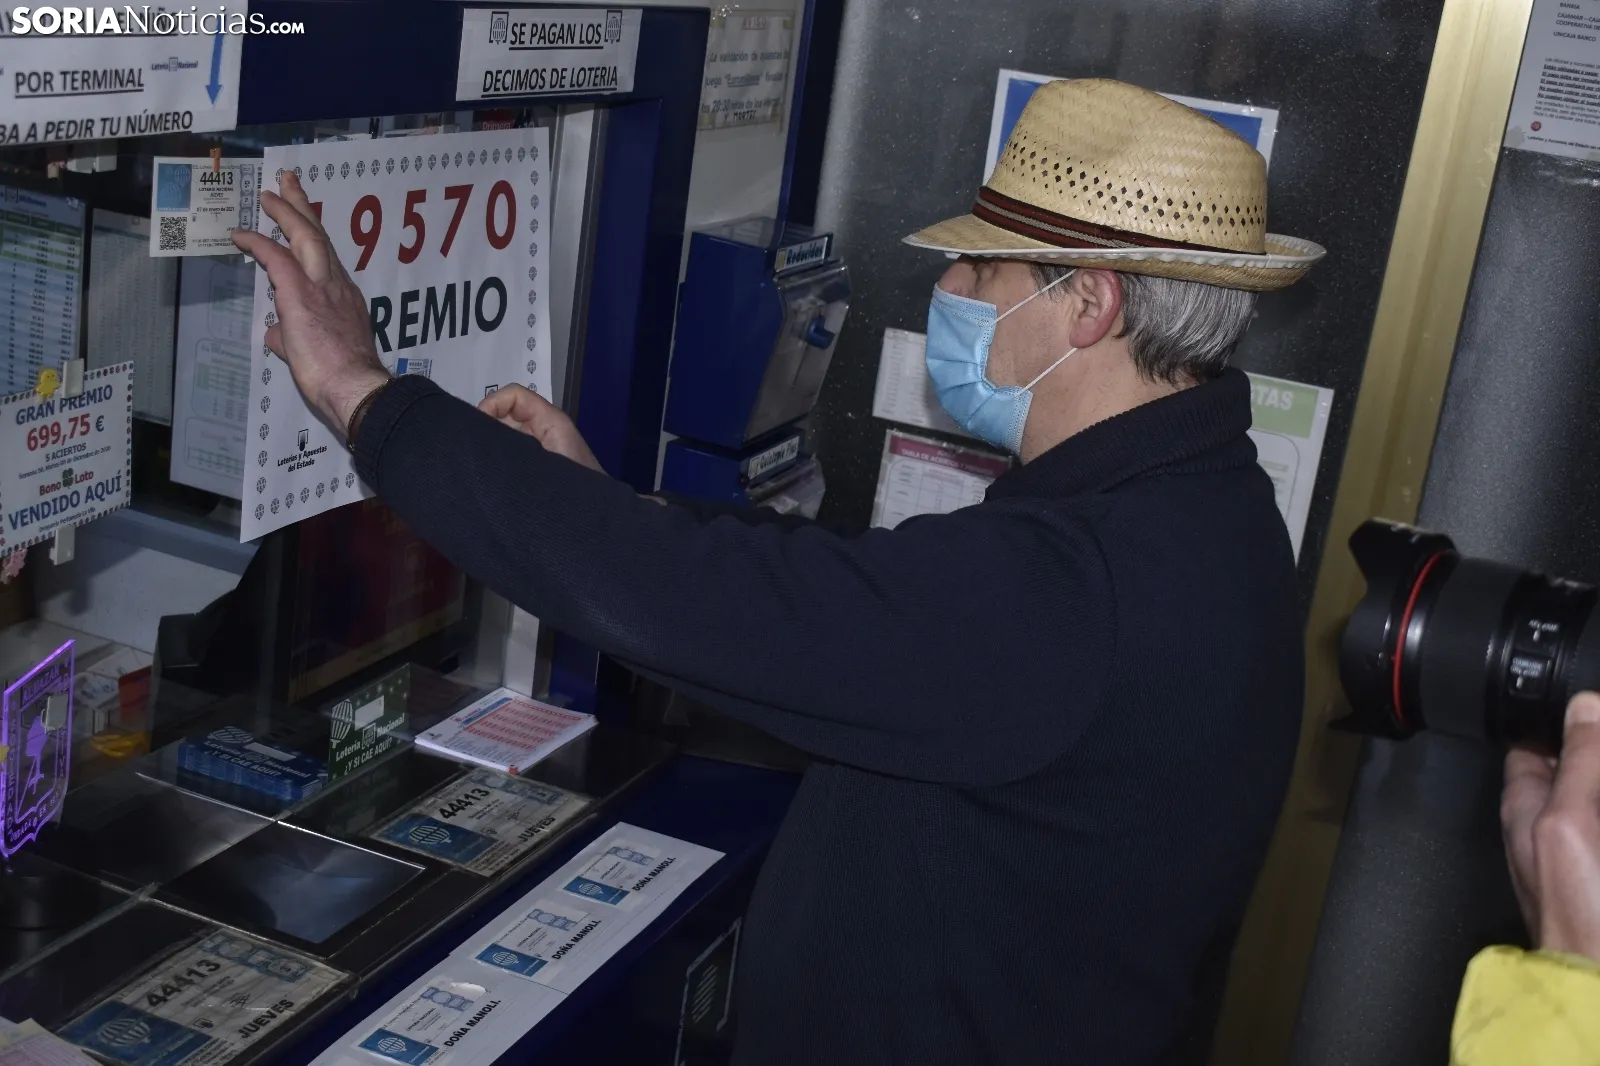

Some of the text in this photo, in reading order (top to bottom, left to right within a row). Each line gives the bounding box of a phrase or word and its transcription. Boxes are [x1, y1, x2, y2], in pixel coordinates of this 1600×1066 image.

[509, 22, 602, 45] SE PAGAN LOS
[15, 68, 144, 93] POR TERMINAL
[482, 66, 618, 93] DECIMOS DE LOTERIA
[25, 122, 38, 142] A
[44, 118, 95, 140] PEDIR
[100, 117, 121, 137] TU
[126, 109, 194, 135] NÚMERO
[200, 171, 234, 185] 44413
[309, 179, 517, 273] 9570
[371, 276, 508, 354] REMIO
[16, 384, 114, 426] GRAN PREMIO
[27, 413, 105, 452] 699,75 €
[45, 442, 87, 463] 5 ACIERTOS
[303, 446, 328, 458] Apuestas
[288, 458, 315, 472] del Estado
[39, 470, 94, 496] Bono Loto
[8, 469, 122, 531] VENDIDO AQUÍ
[377, 712, 405, 739] Nacional
[231, 757, 250, 767] CAE
[264, 760, 312, 779] Nacional
[361, 749, 374, 765] CAE
[438, 787, 490, 819] 44413
[632, 874, 653, 891] DOÑA
[551, 941, 575, 960] DOÑA
[146, 958, 222, 1008] 44413
[238, 998, 295, 1039] JUEVES
[443, 1025, 470, 1048] DOÑA
